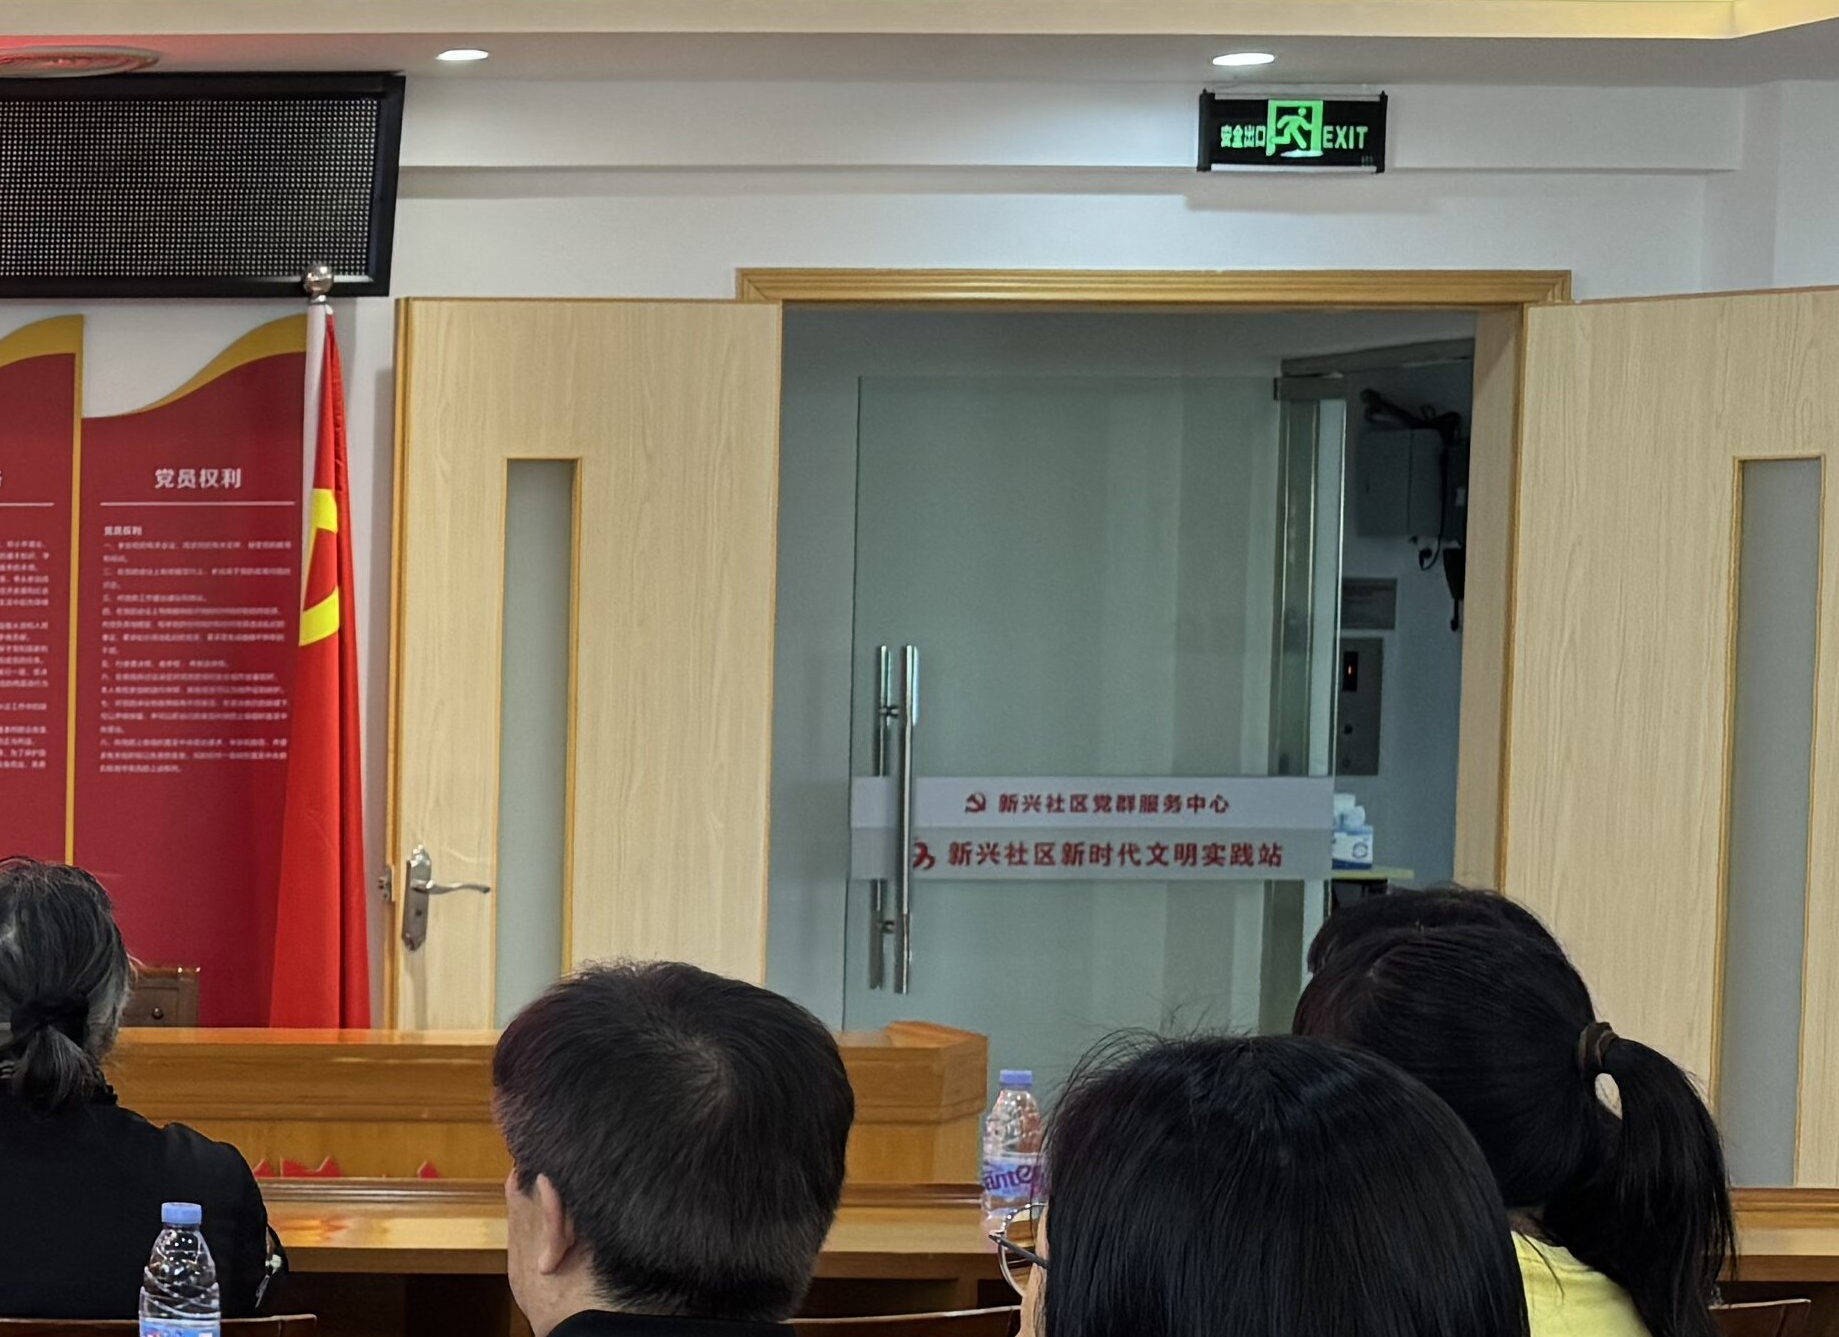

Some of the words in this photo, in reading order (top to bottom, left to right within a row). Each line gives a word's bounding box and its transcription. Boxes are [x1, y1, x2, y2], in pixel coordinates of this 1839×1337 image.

[1220, 123, 1266, 148] 安全出口
[1322, 125, 1369, 150] EXIT
[154, 467, 243, 490] 党员权利
[998, 793, 1230, 815] 新兴社区党群服务中心
[948, 841, 1283, 868] 新兴社区新时代文明实践站
